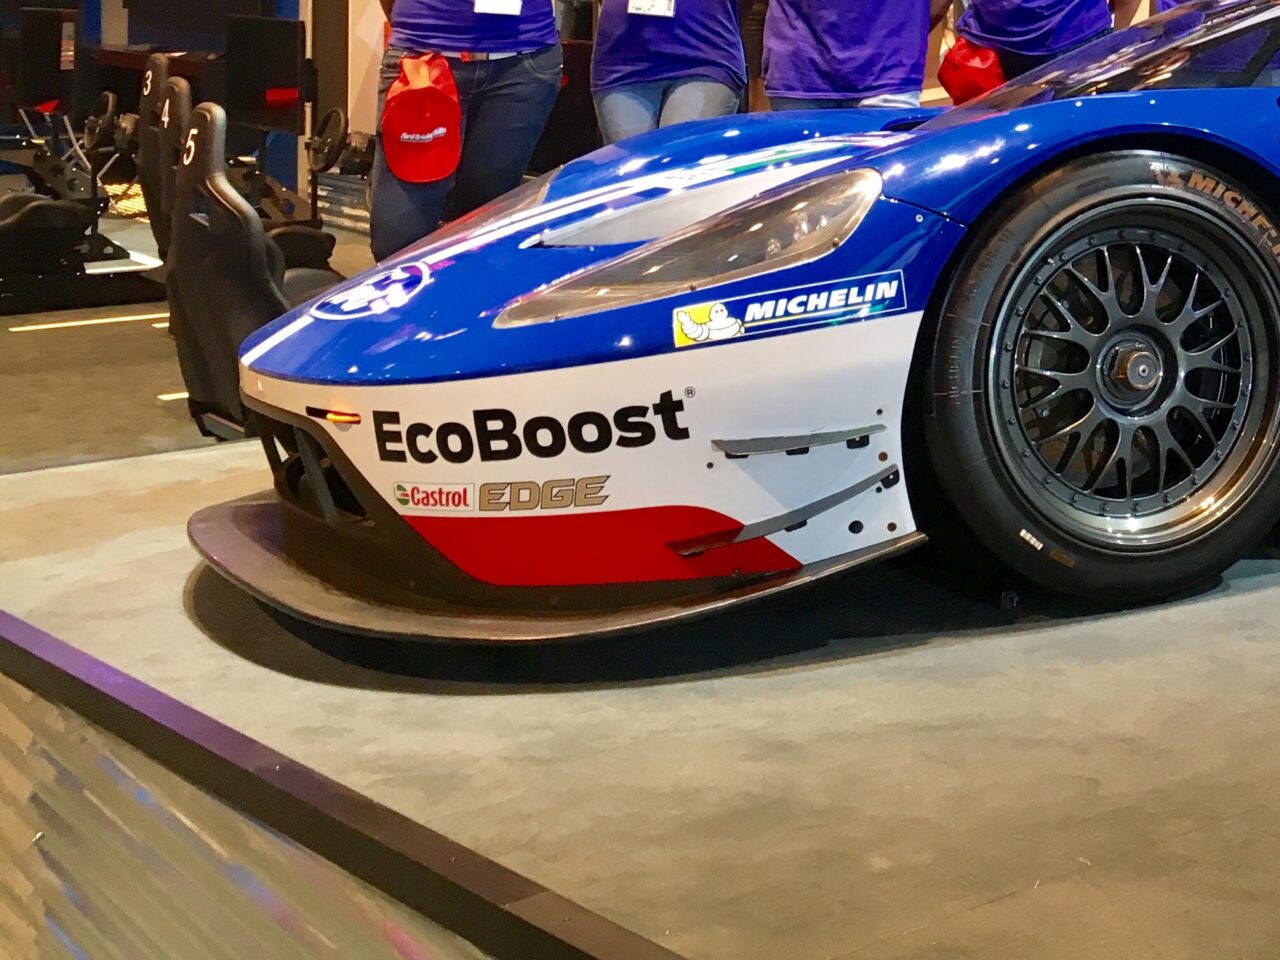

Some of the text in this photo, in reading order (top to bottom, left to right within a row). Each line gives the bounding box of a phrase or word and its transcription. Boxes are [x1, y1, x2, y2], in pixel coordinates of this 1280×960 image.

[143, 70, 153, 96] 3
[161, 98, 170, 129] 4
[183, 128, 199, 166] 5
[744, 280, 899, 322] MICHELIN
[410, 475, 611, 512] Castrol EDGE
